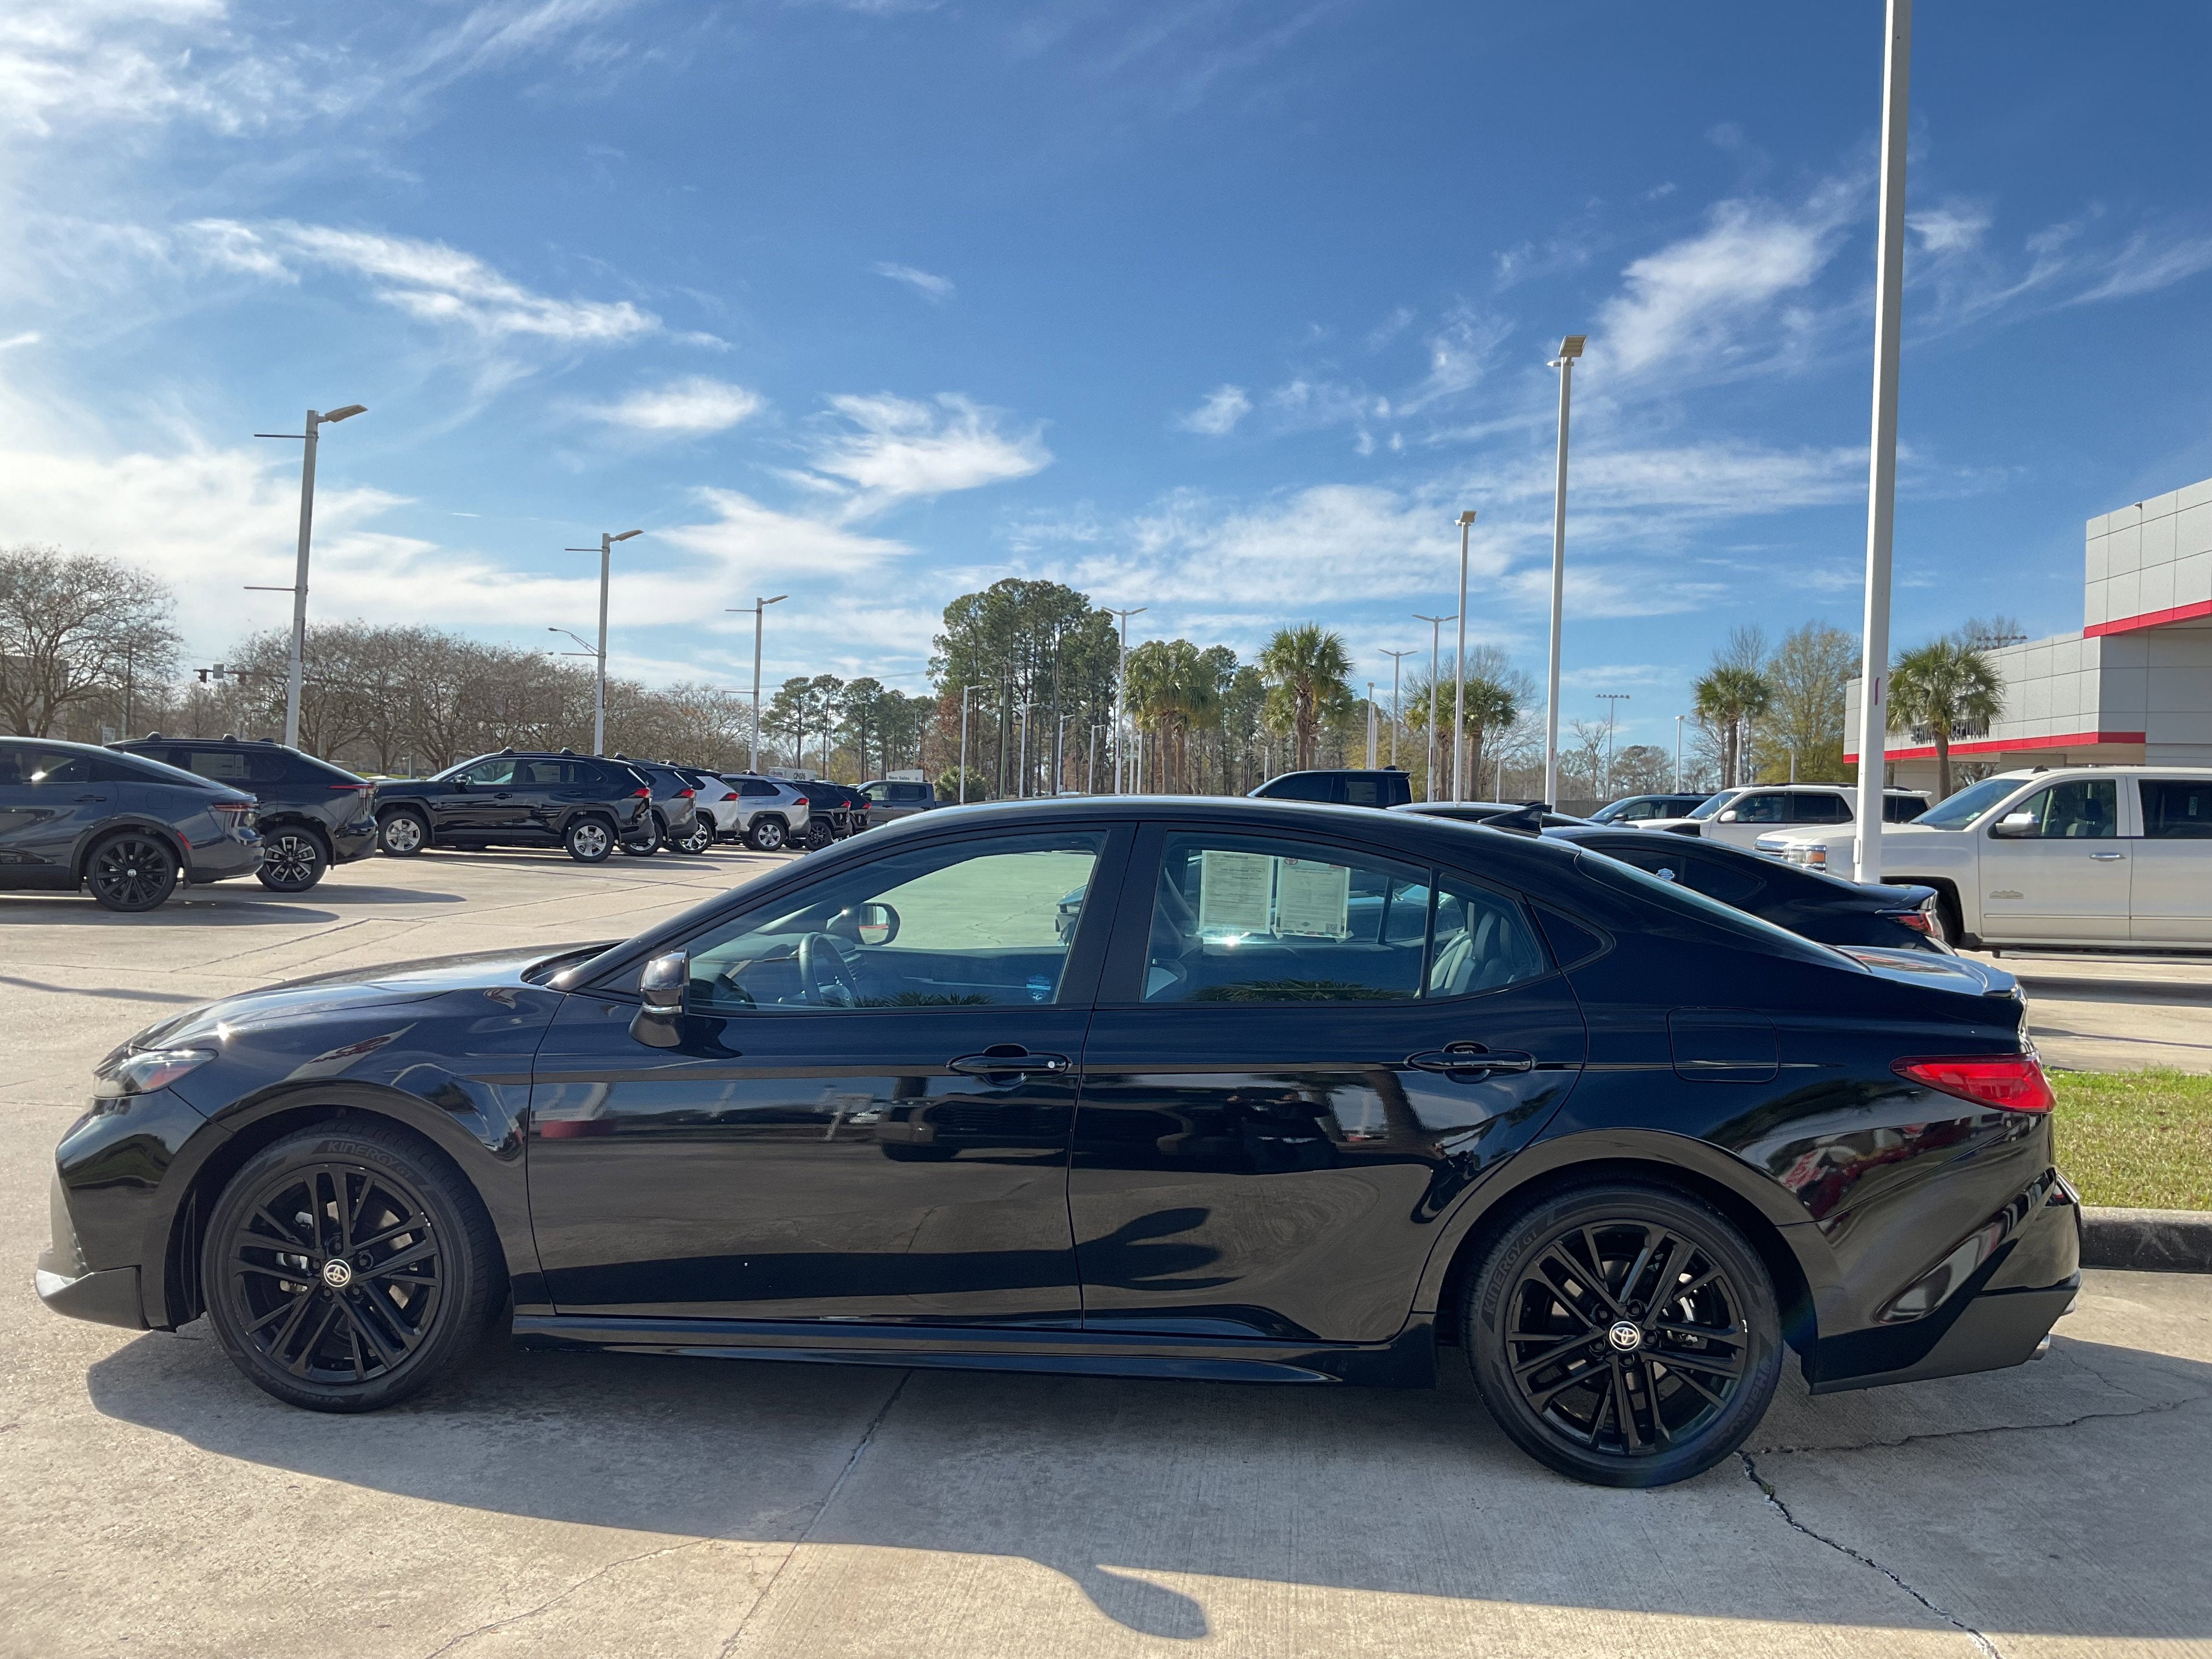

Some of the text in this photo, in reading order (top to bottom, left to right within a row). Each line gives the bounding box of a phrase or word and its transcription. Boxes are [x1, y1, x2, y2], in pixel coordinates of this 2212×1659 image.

[327, 1141, 415, 1179] KINERGY GT
[1483, 1229, 1537, 1314] KINERGY GT
